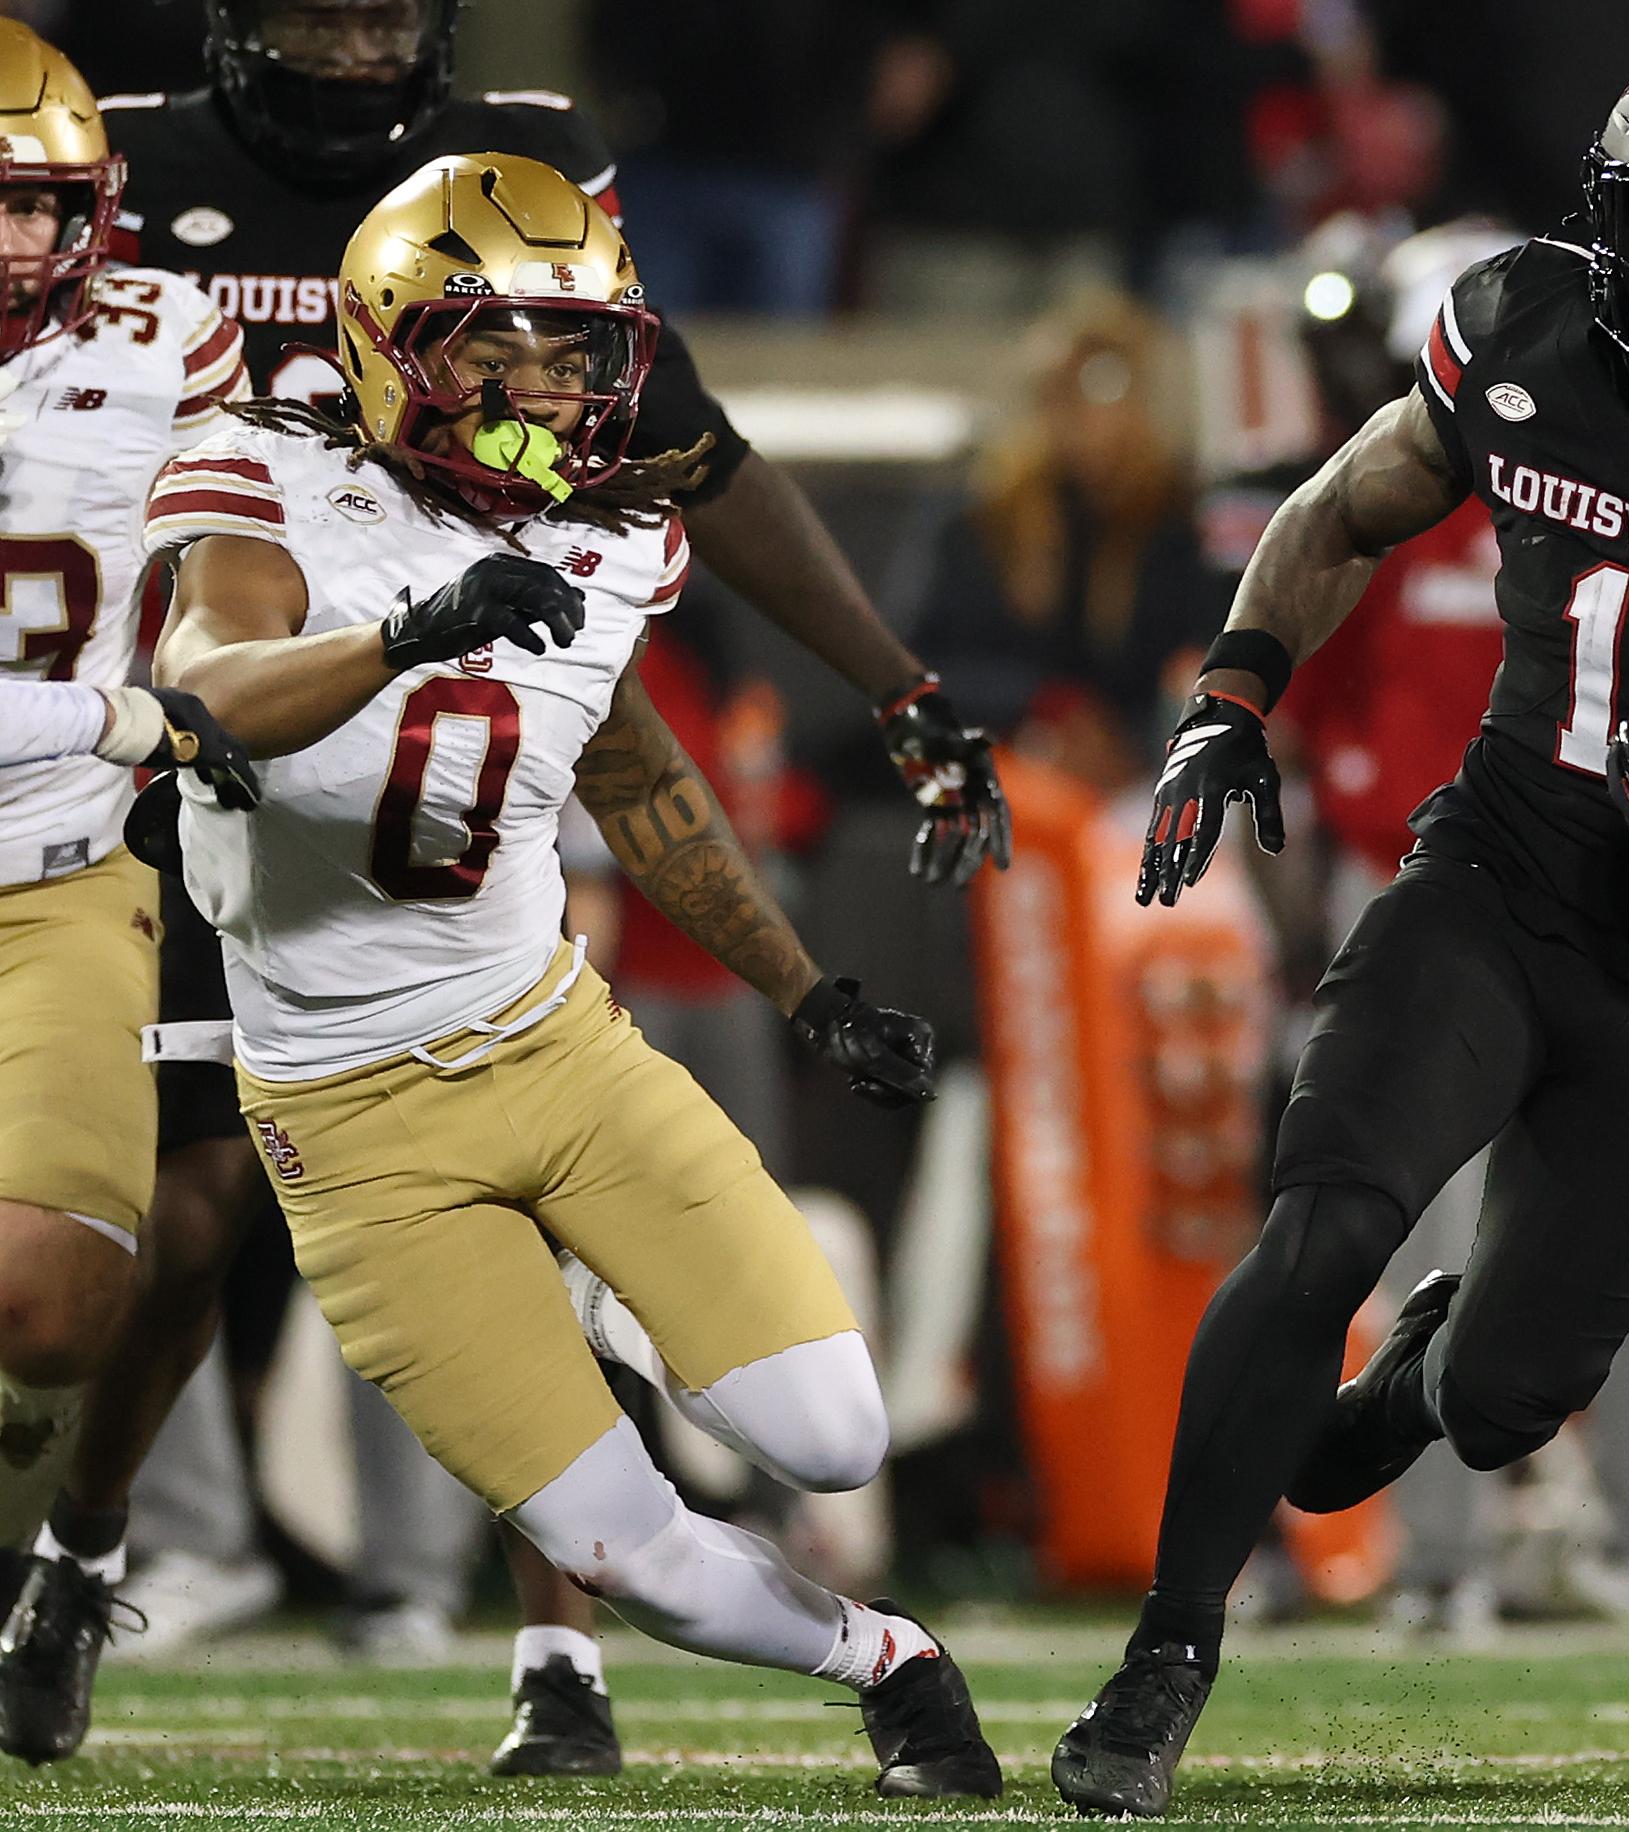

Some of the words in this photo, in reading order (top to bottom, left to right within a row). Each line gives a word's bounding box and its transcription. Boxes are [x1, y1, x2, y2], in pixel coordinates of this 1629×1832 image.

[445, 284, 492, 296] OAKLEY
[1495, 392, 1529, 410] ACC
[335, 492, 378, 513] ACC
[369, 672, 524, 905] 0
